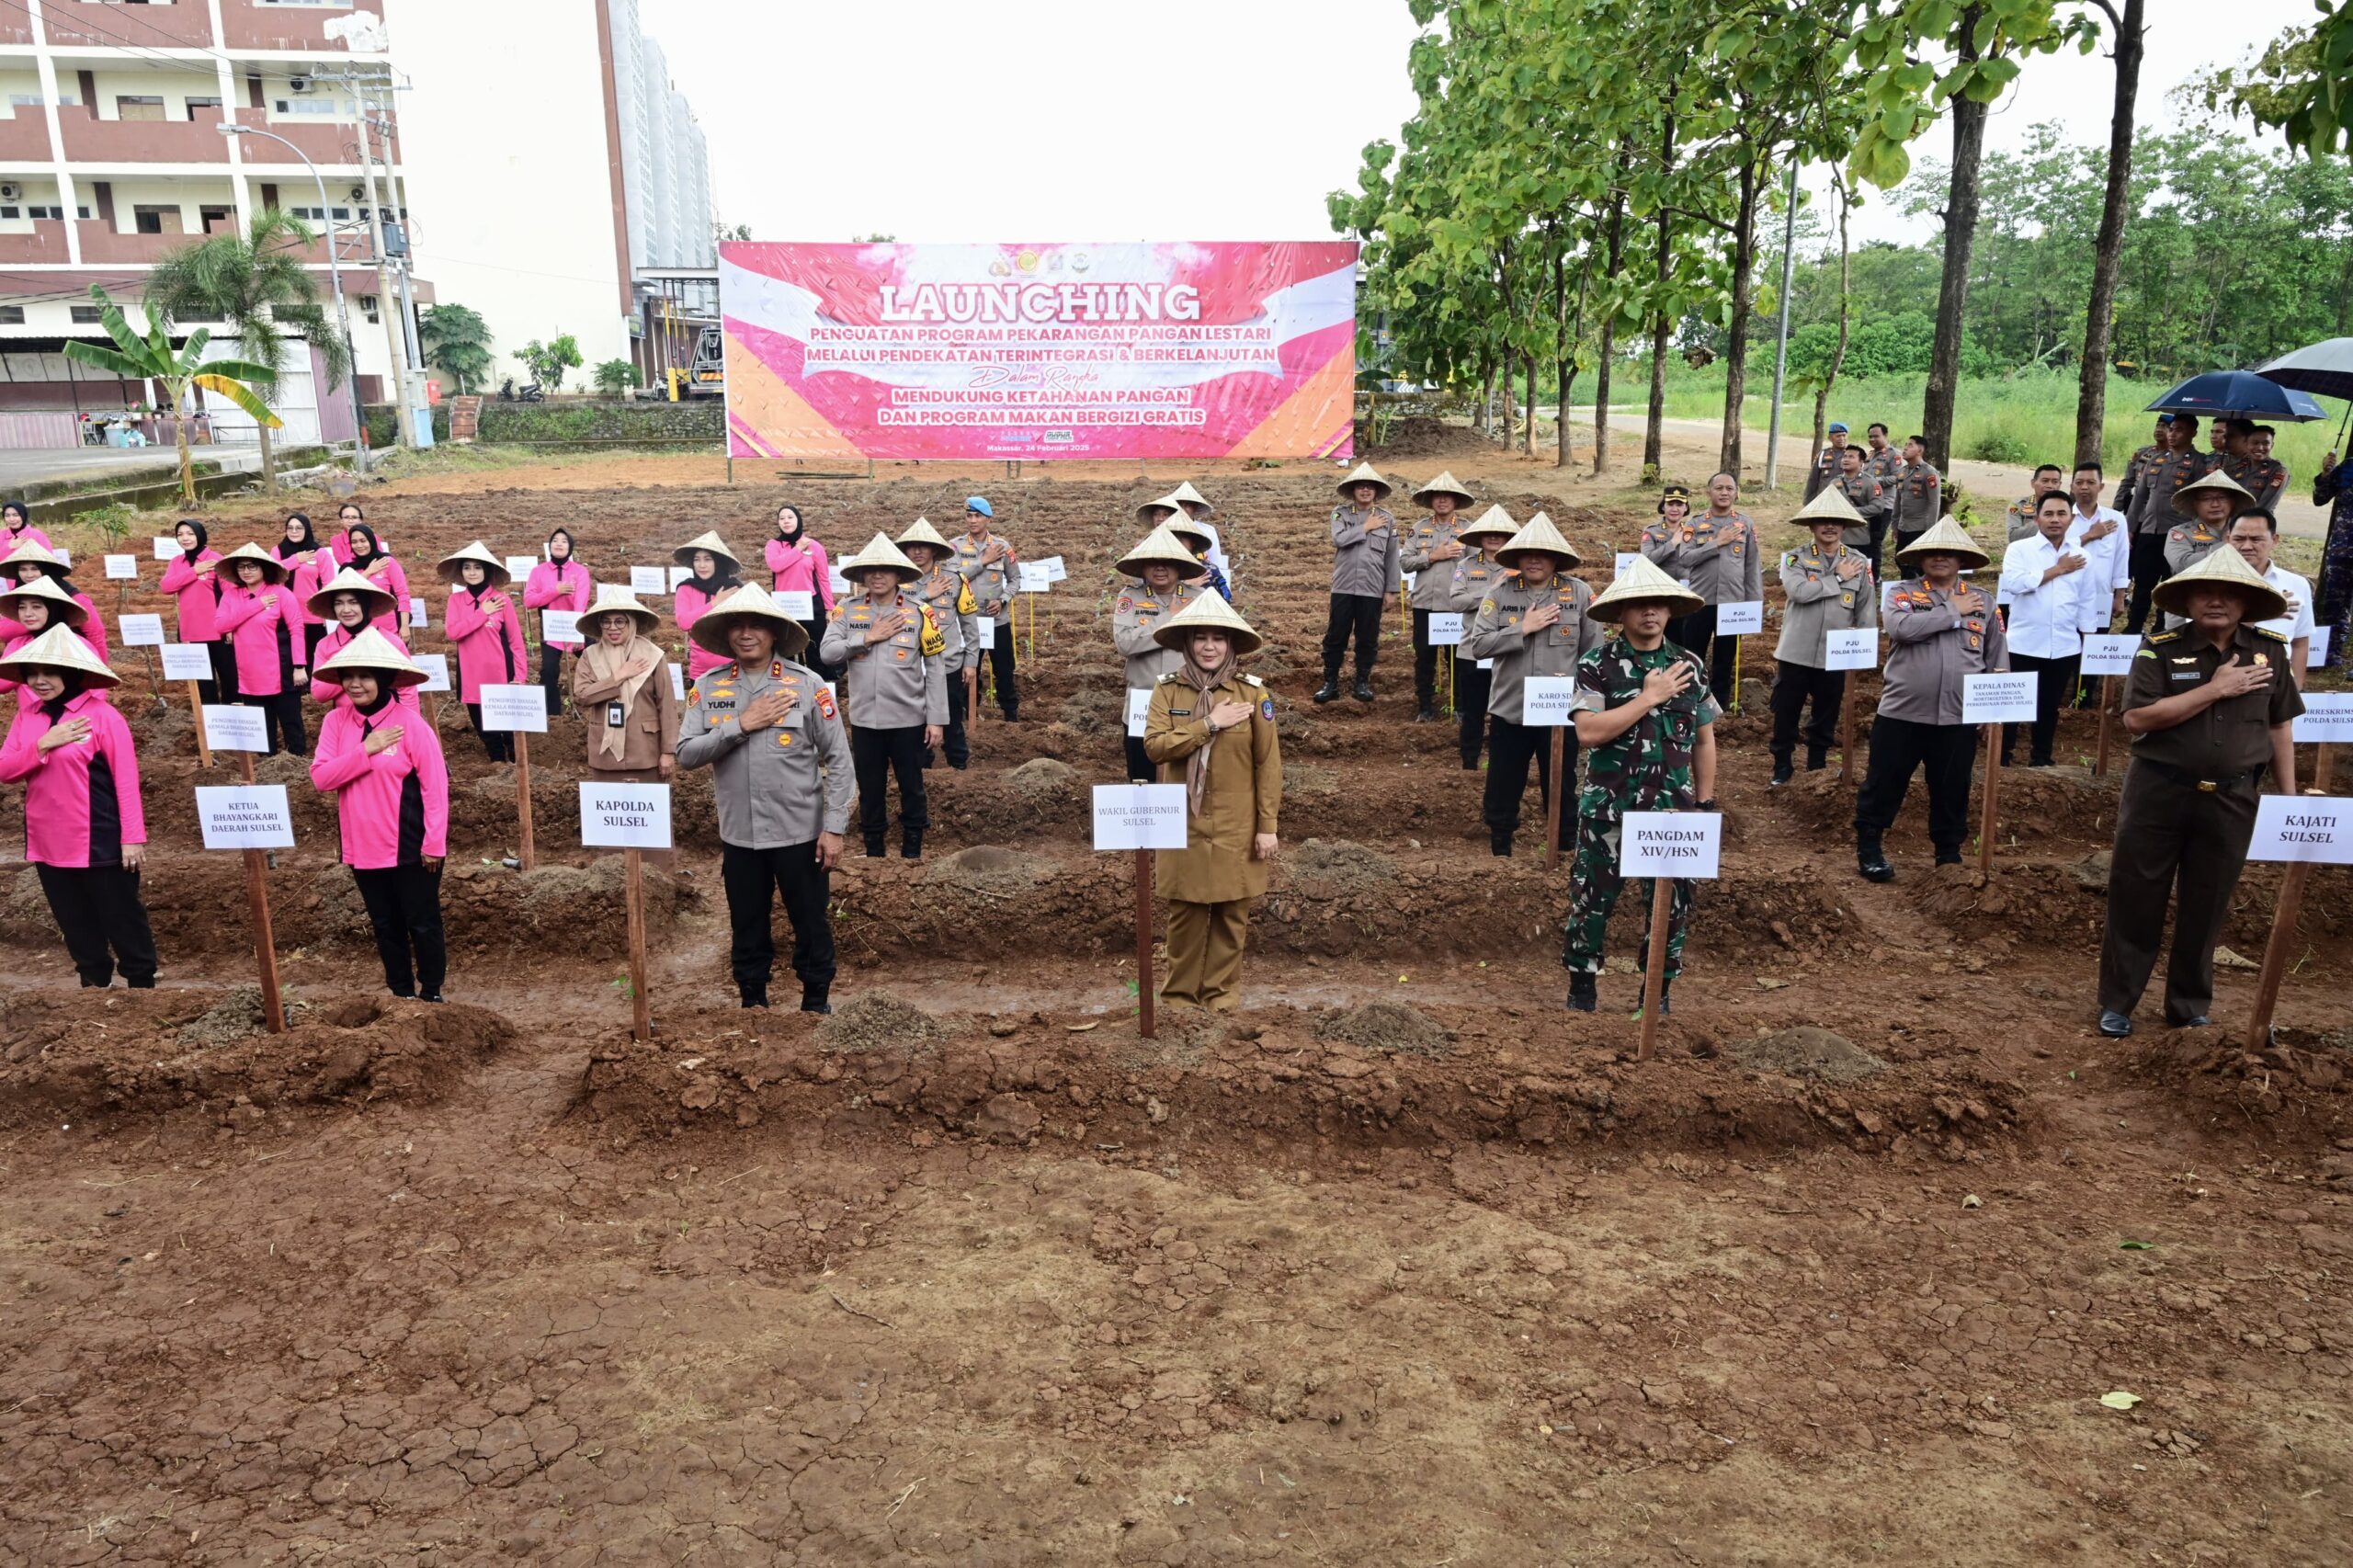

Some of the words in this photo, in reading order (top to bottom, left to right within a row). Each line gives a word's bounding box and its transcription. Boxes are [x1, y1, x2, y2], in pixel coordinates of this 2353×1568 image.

[879, 283, 1200, 322] LAUNCHING
[811, 327, 915, 341] PENGUATAN
[917, 328, 1004, 341] PROGRAM
[1006, 328, 1125, 340] PEKARANGAN
[1129, 328, 1202, 340] PANGAN
[1205, 327, 1271, 340] LESTARI
[807, 349, 875, 361] MELALUI
[879, 349, 992, 362] PENDEKATAN
[995, 349, 1114, 362] TERINTEGRASI
[1119, 349, 1130, 361] &
[1133, 348, 1276, 361] BERKELANJUTAN
[968, 364, 1040, 389] Dalam
[1045, 364, 1099, 392] Rangka
[894, 390, 1004, 403] MENDUKUNG
[1007, 390, 1113, 403] KETAHANAN
[1116, 390, 1189, 403] PANGAN
[880, 411, 918, 424] DAN
[921, 411, 1006, 424] PROGRAM
[1008, 411, 1073, 423] MAKAN
[1076, 410, 1140, 423] BERGIZI
[1142, 410, 1205, 423] GRATIS
[986, 444, 1024, 452] Makassar,
[2003, 681, 2026, 689] DINAS
[708, 700, 735, 710] YUDHI
[228, 801, 259, 811] KETUA
[596, 800, 654, 812] KAPOLDA
[1098, 807, 1129, 816] WAKIL
[1130, 805, 1180, 815] GUBERNUR
[213, 812, 278, 822] BHAYANGKARI
[603, 815, 648, 827] SULSEL
[1122, 817, 1156, 826] SULSEL
[2285, 815, 2336, 829] KAJATI
[211, 824, 248, 833] DAERAH
[250, 824, 284, 832] SULSEL
[1637, 830, 1704, 841] PANGDAM
[2279, 831, 2334, 844] SULSEL
[1641, 846, 1699, 859] XIV/HSN
